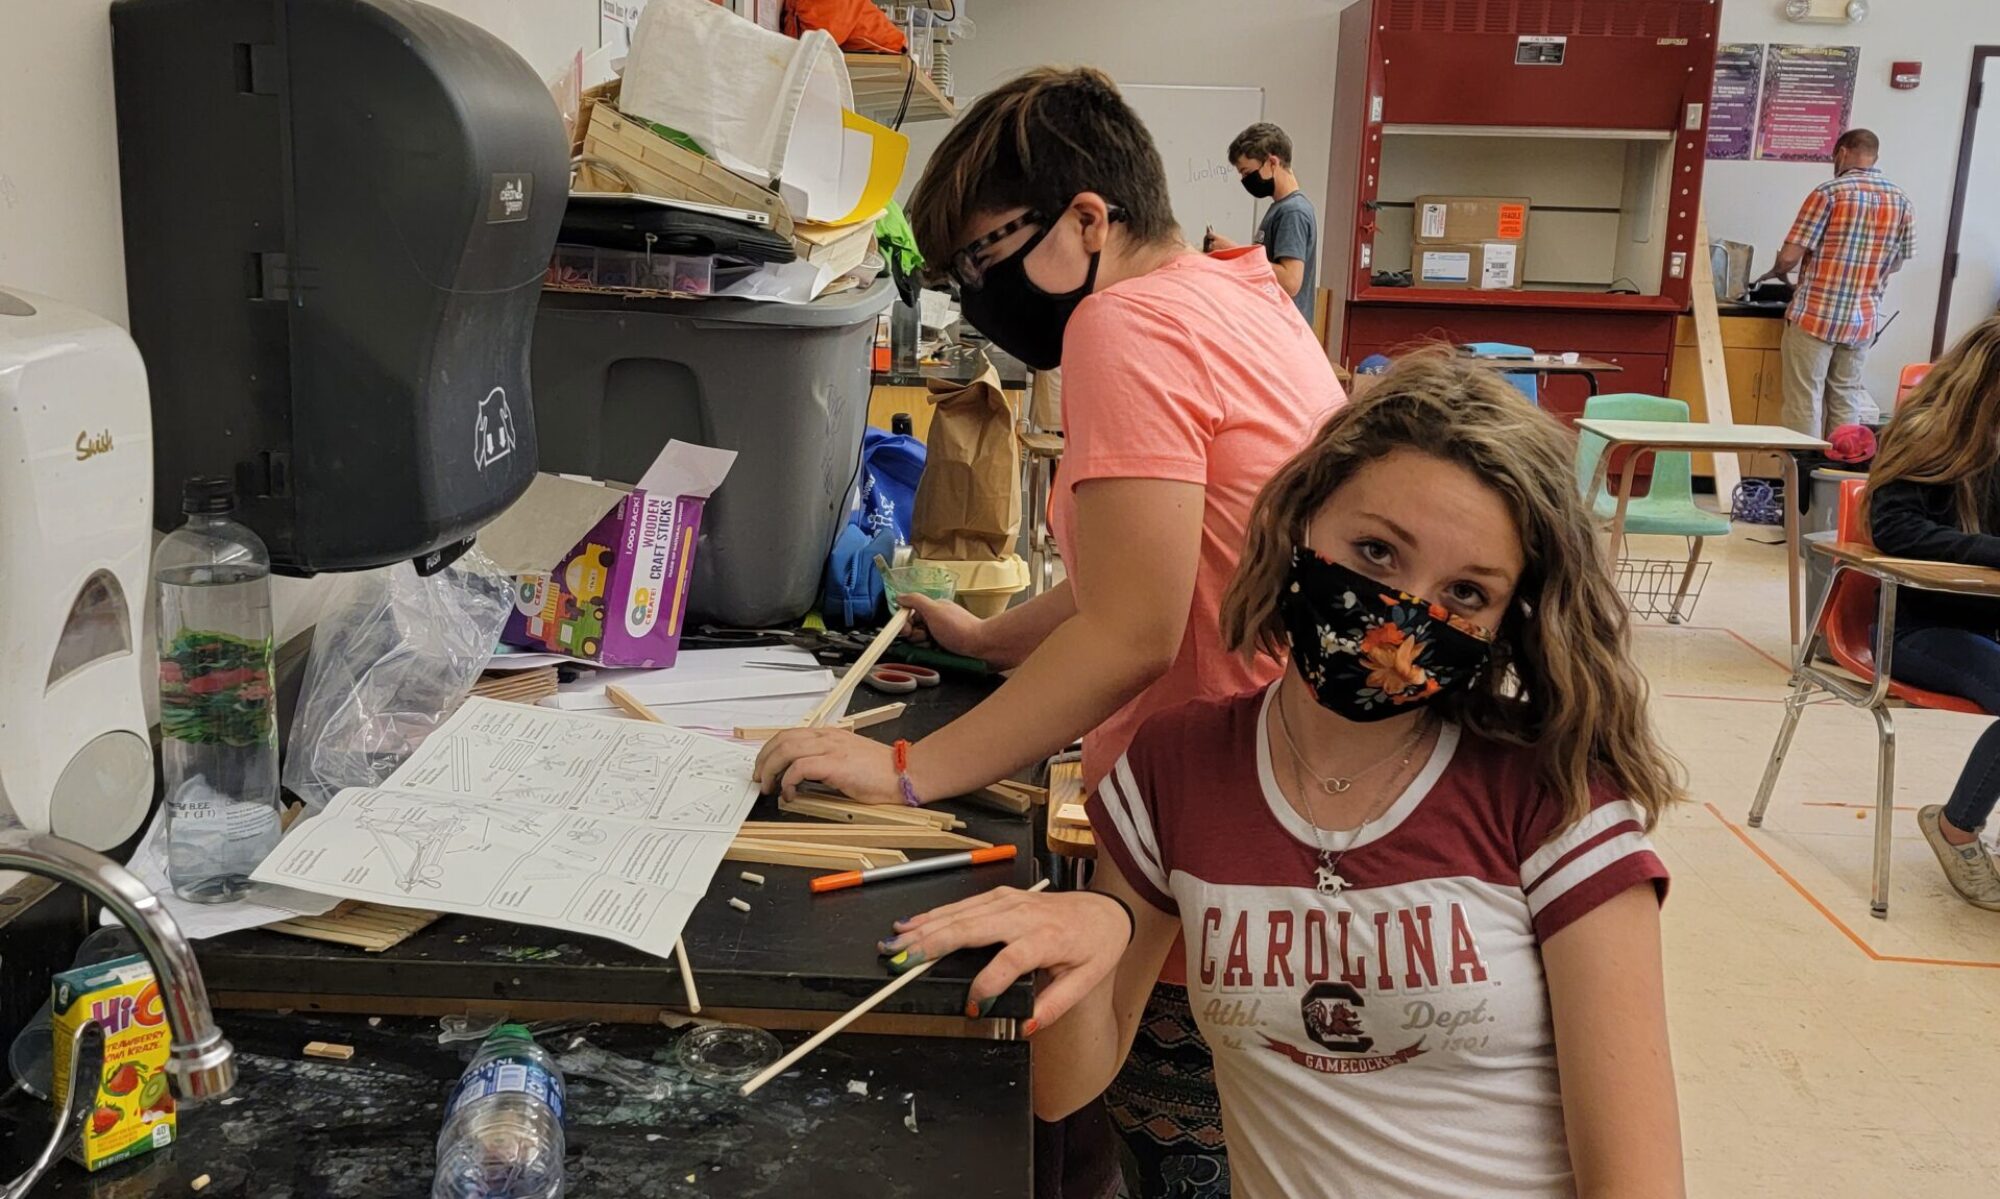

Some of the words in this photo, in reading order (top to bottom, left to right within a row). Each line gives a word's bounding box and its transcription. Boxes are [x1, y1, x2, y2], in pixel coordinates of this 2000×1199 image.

[643, 499, 660, 548] WOODEN
[657, 500, 672, 541] STICKS
[650, 543, 666, 580] CRAFT
[1200, 901, 1489, 991] CAROLINA
[1202, 998, 1269, 1028] Athl.
[1401, 998, 1495, 1036] Dept.
[106, 1029, 166, 1052] TRAWBERRY
[1305, 1055, 1394, 1074] GAMECOCKS
